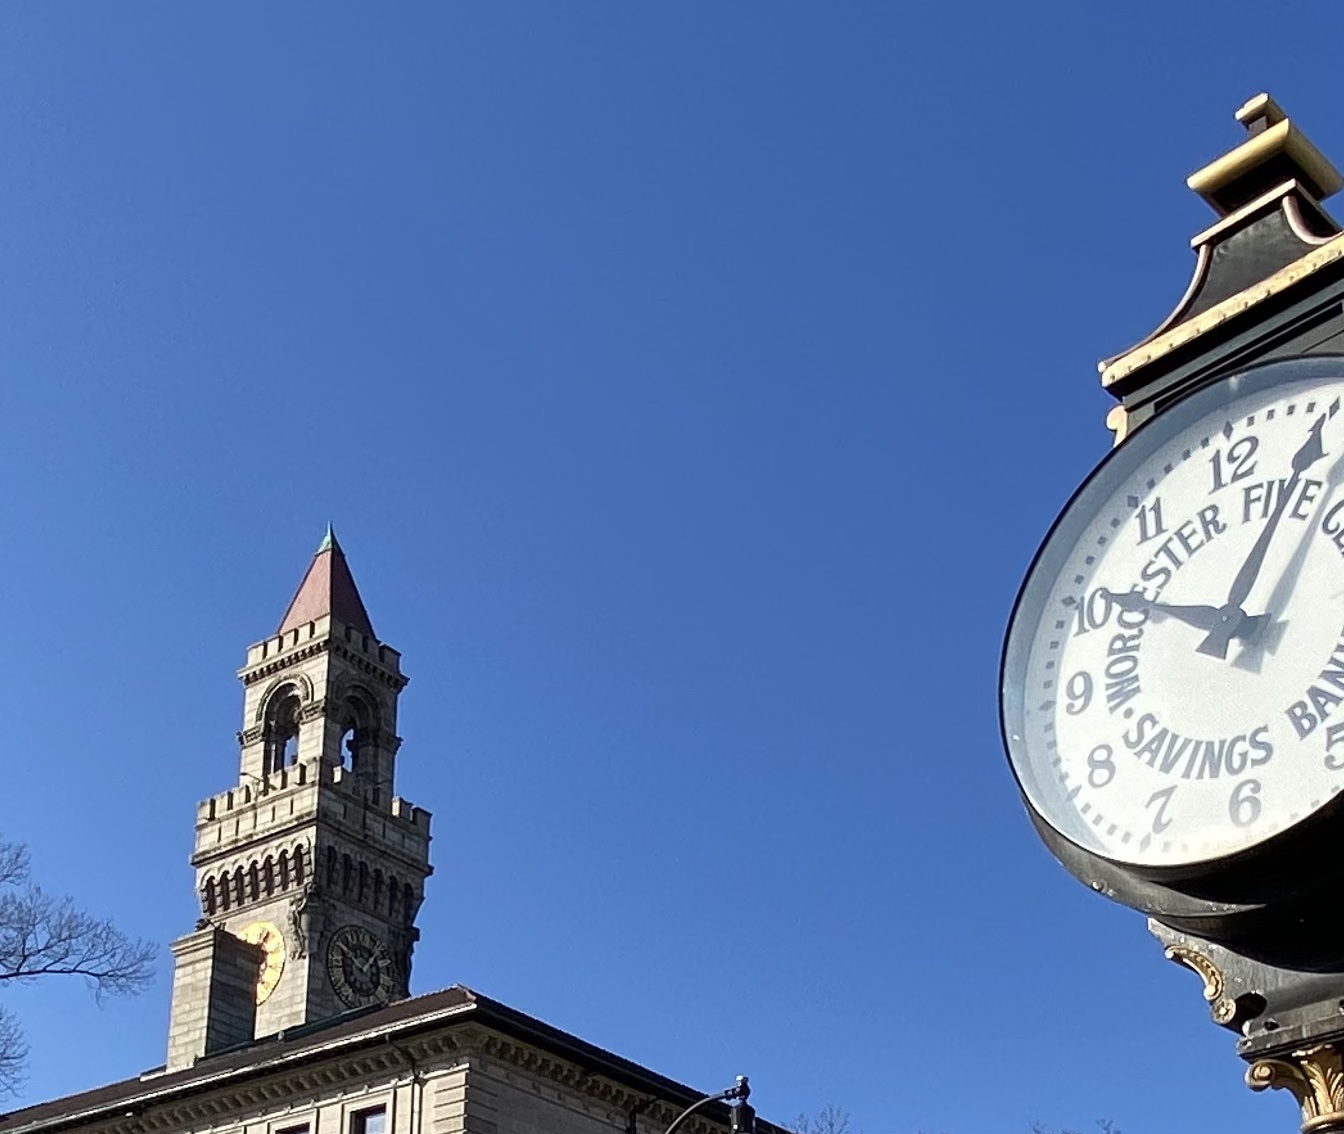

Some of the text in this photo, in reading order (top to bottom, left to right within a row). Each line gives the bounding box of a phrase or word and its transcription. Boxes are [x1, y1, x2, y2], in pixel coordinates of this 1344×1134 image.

[1207, 435, 1260, 494] 12
[1135, 497, 1168, 546] 11
[1073, 586, 1114, 637] 10
[1065, 670, 1094, 716] 9
[1086, 743, 1117, 789] 8
[1122, 712, 1275, 781] SAVINGS
[1143, 784, 1179, 833] 7
[1228, 779, 1263, 829] 6
